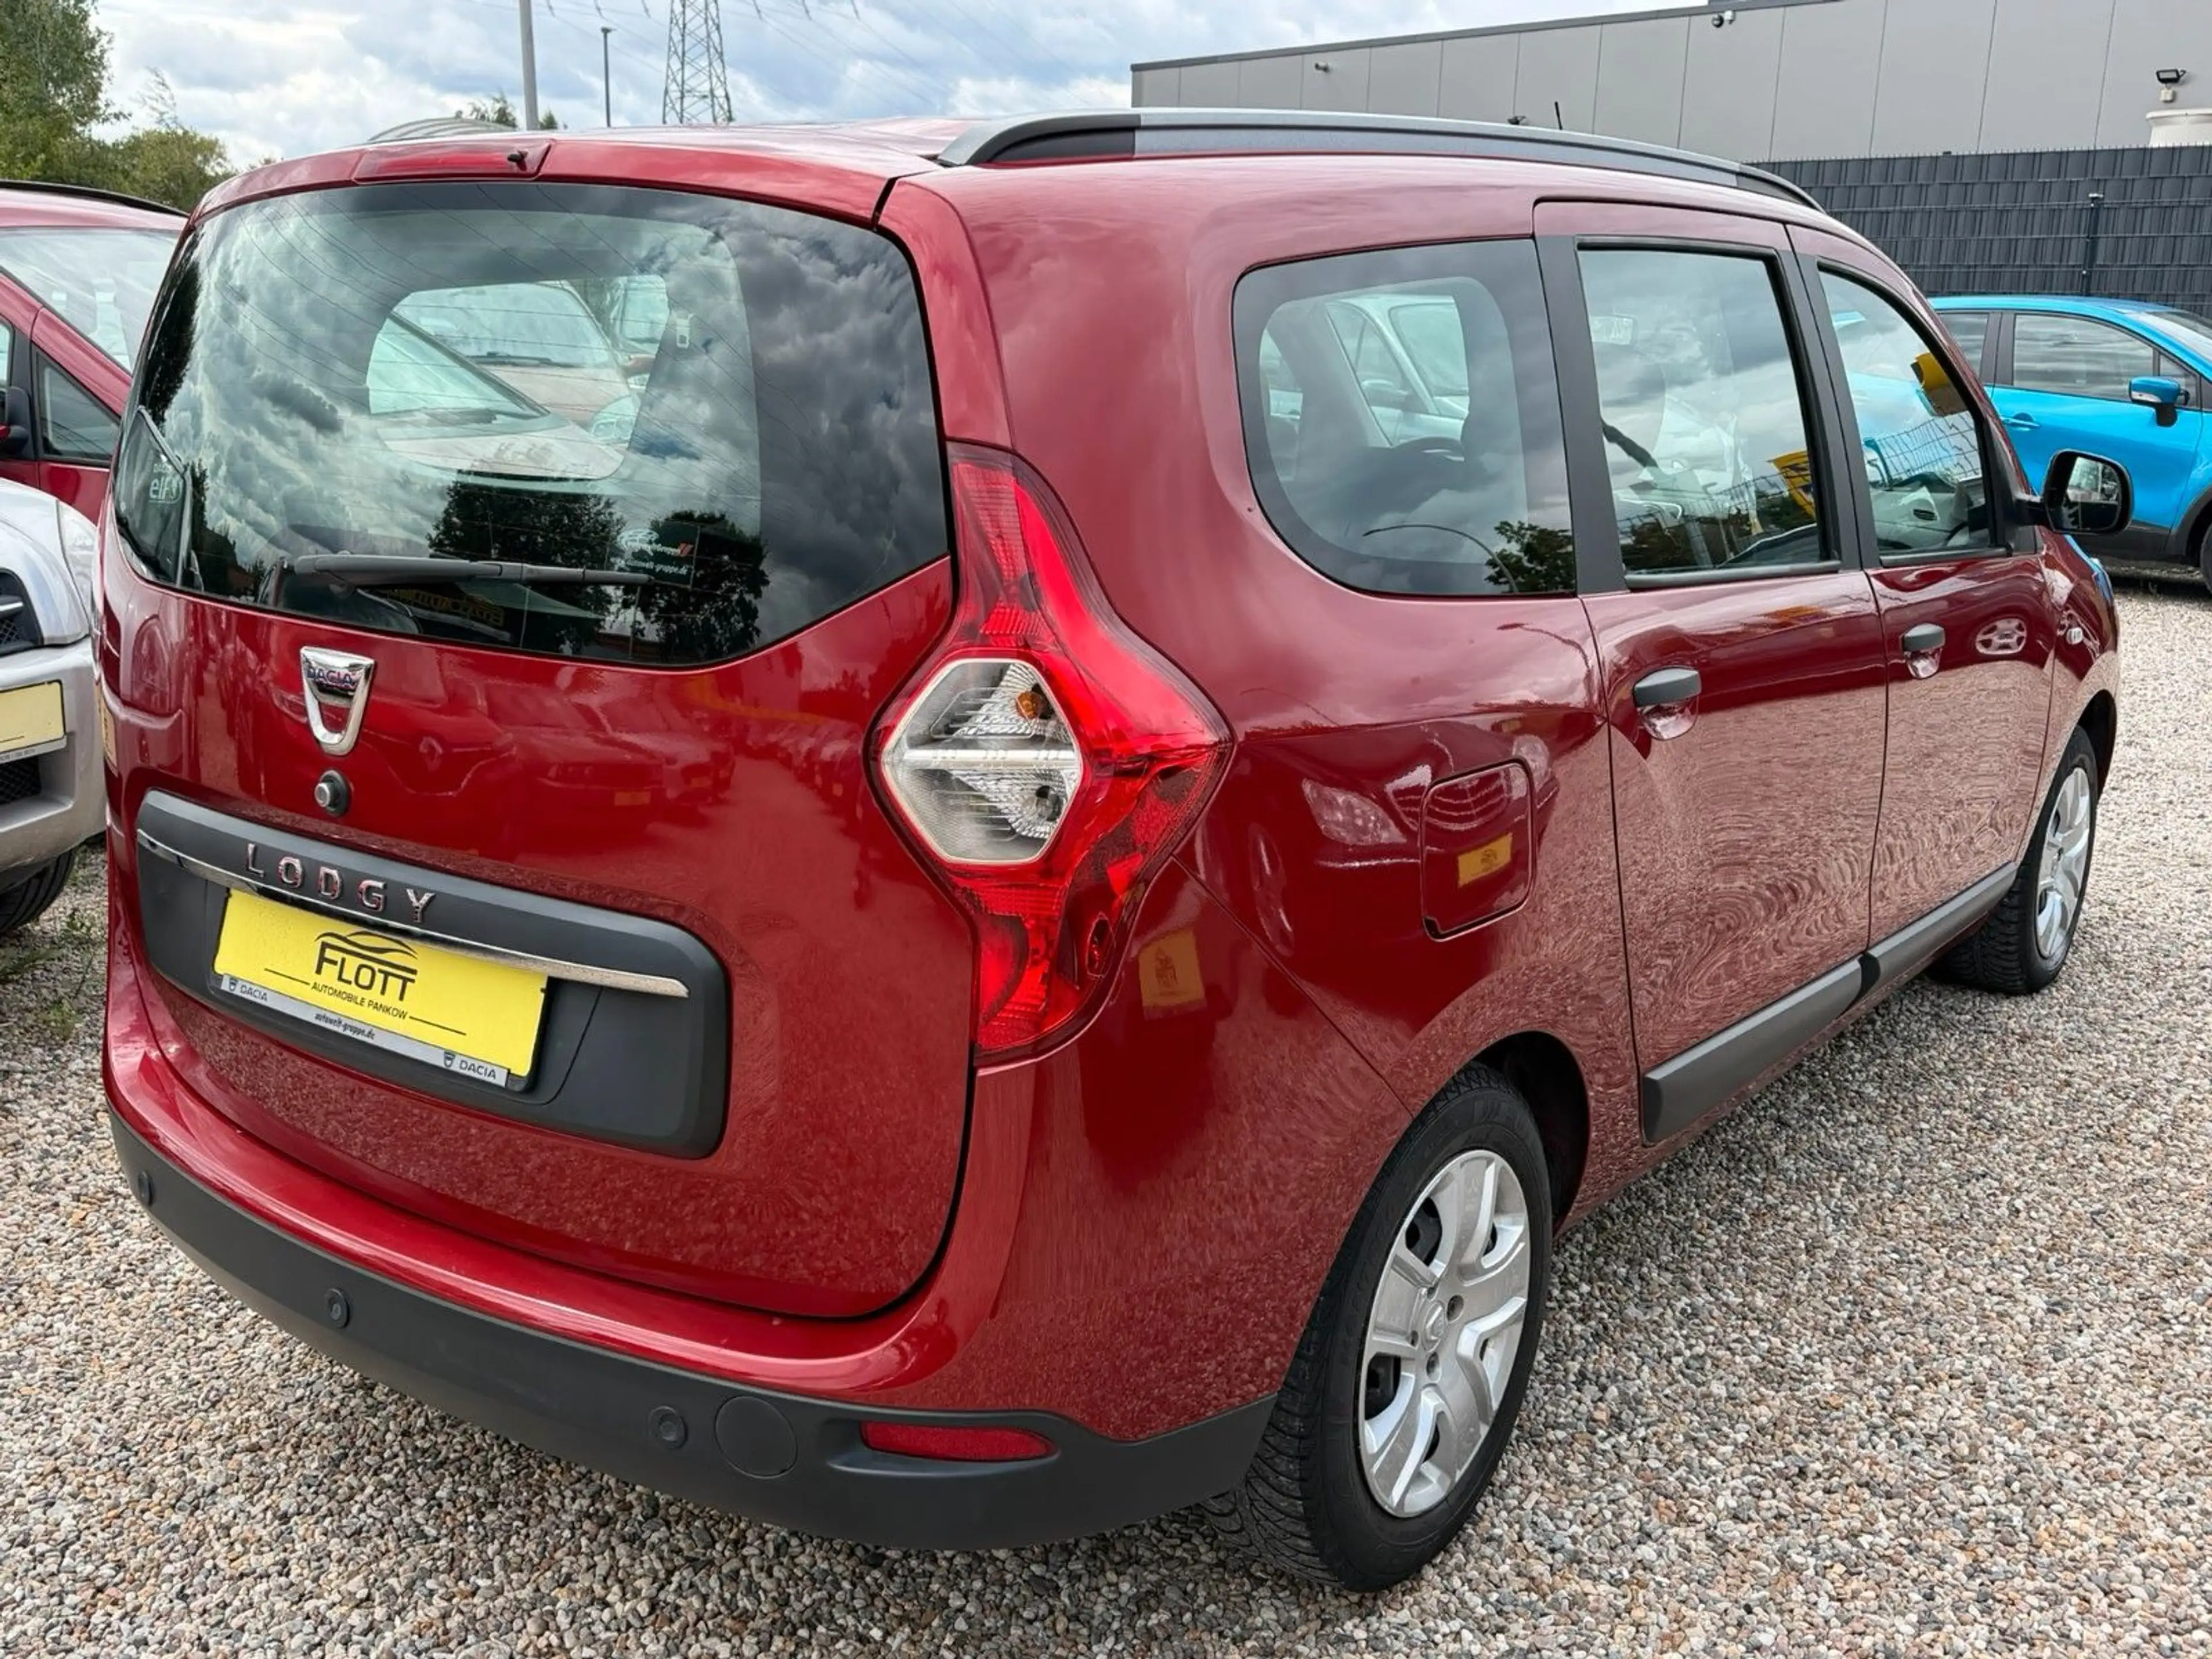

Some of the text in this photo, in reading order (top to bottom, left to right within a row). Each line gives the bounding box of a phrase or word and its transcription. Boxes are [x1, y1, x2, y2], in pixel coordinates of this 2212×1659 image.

[306, 668, 353, 685] DACIA
[246, 843, 435, 923] LODGY
[315, 940, 418, 1002] FLOTT
[240, 983, 268, 1002] DACIA
[311, 981, 408, 1019] AUTOMOBILE PANKOW
[459, 1059, 497, 1080] DACIA
